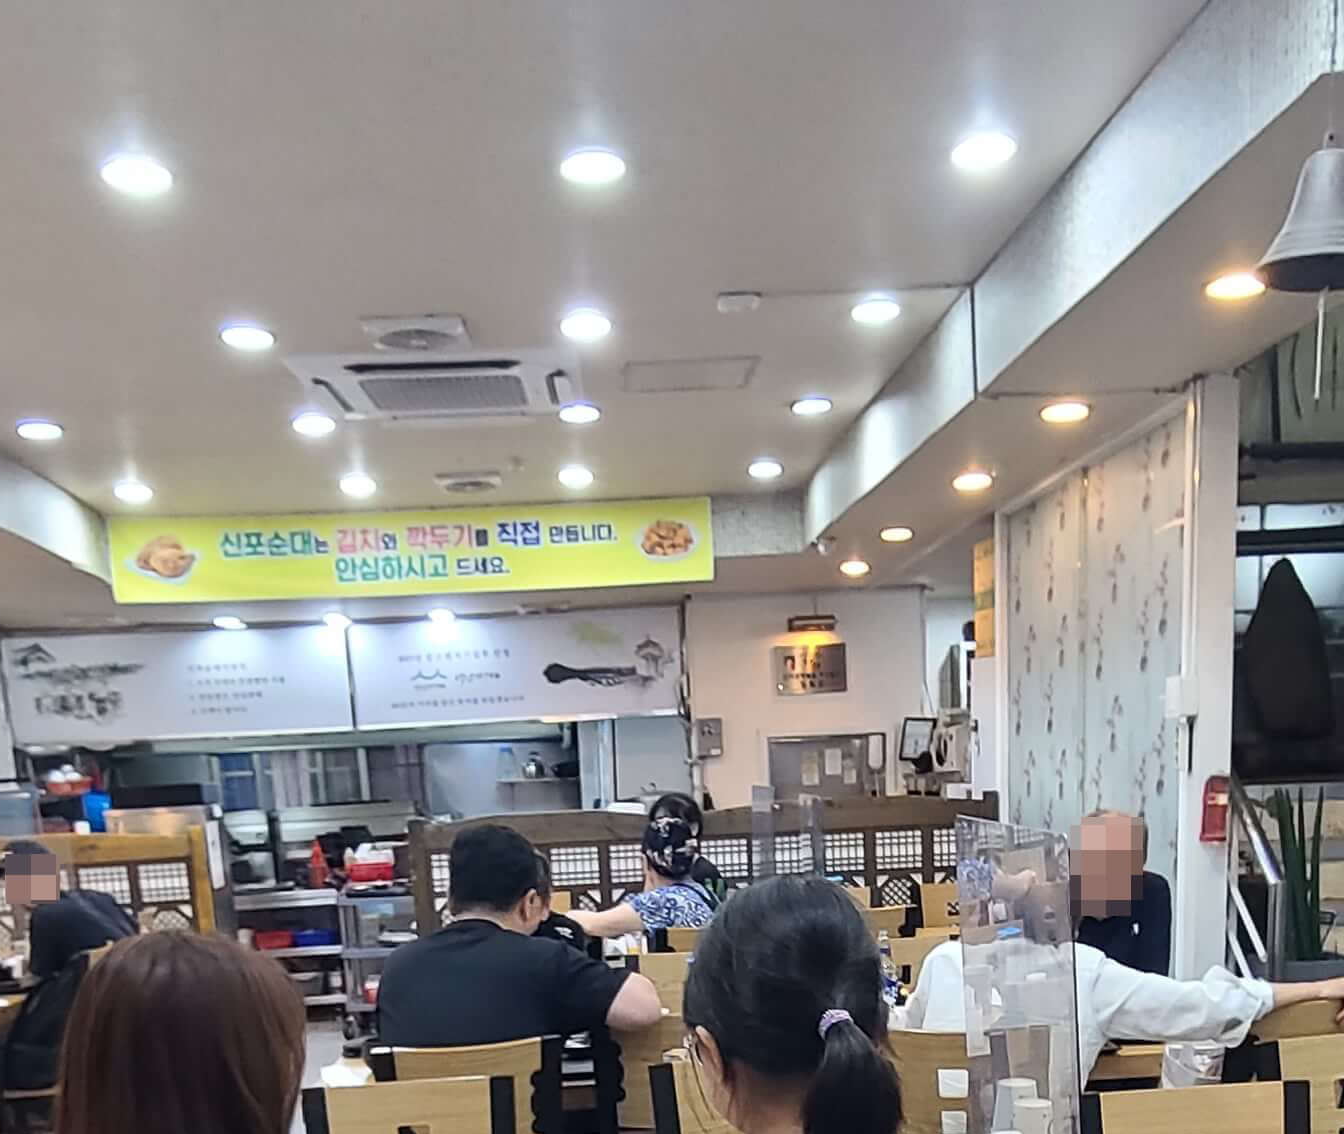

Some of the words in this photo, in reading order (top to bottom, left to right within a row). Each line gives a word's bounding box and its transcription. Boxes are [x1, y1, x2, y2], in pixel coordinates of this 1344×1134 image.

[220, 529, 329, 558] 신포순대는
[336, 528, 397, 554] 김치와
[406, 523, 489, 549] 깍두기를
[497, 520, 541, 547] 직접
[549, 523, 618, 543] 만듭니다.
[335, 554, 449, 583] 안심하시고
[456, 556, 511, 576] 드세요.
